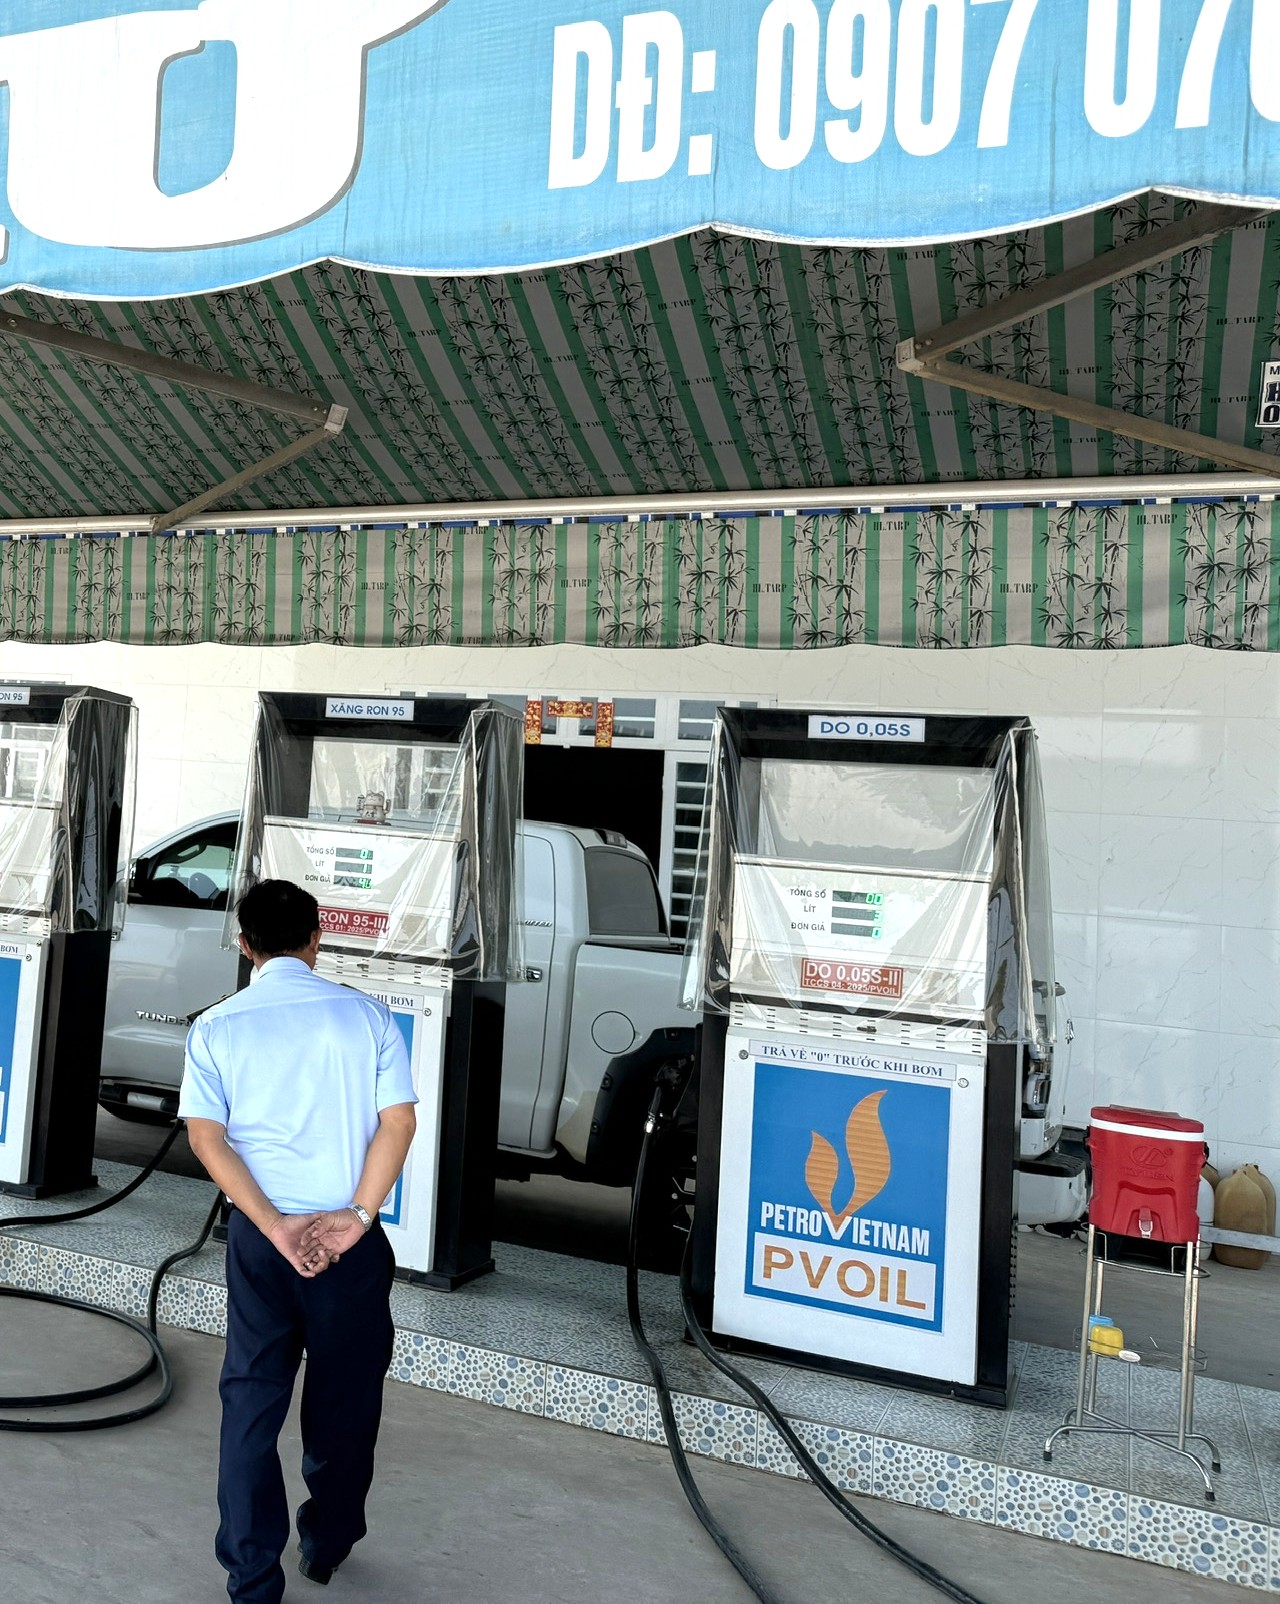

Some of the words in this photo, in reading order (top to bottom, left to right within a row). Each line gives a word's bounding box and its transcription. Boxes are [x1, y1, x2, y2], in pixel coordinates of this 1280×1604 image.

[548, 10, 716, 190] DĐ:
[754, 0, 1038, 170] 0907
[12, 692, 23, 701] 95
[331, 703, 363, 715] XĂNG
[366, 705, 389, 715] RON
[392, 706, 405, 717] 95
[820, 721, 850, 735] DO
[318, 911, 349, 924] RON
[806, 962, 831, 979] DO
[836, 966, 898, 986] 0.05S-II
[804, 978, 829, 988] TCCS
[135, 1010, 192, 1028] TUNDR
[761, 1045, 787, 1057] TRẢ
[883, 1061, 908, 1072] KHI
[763, 1244, 927, 1311] PVOIL
